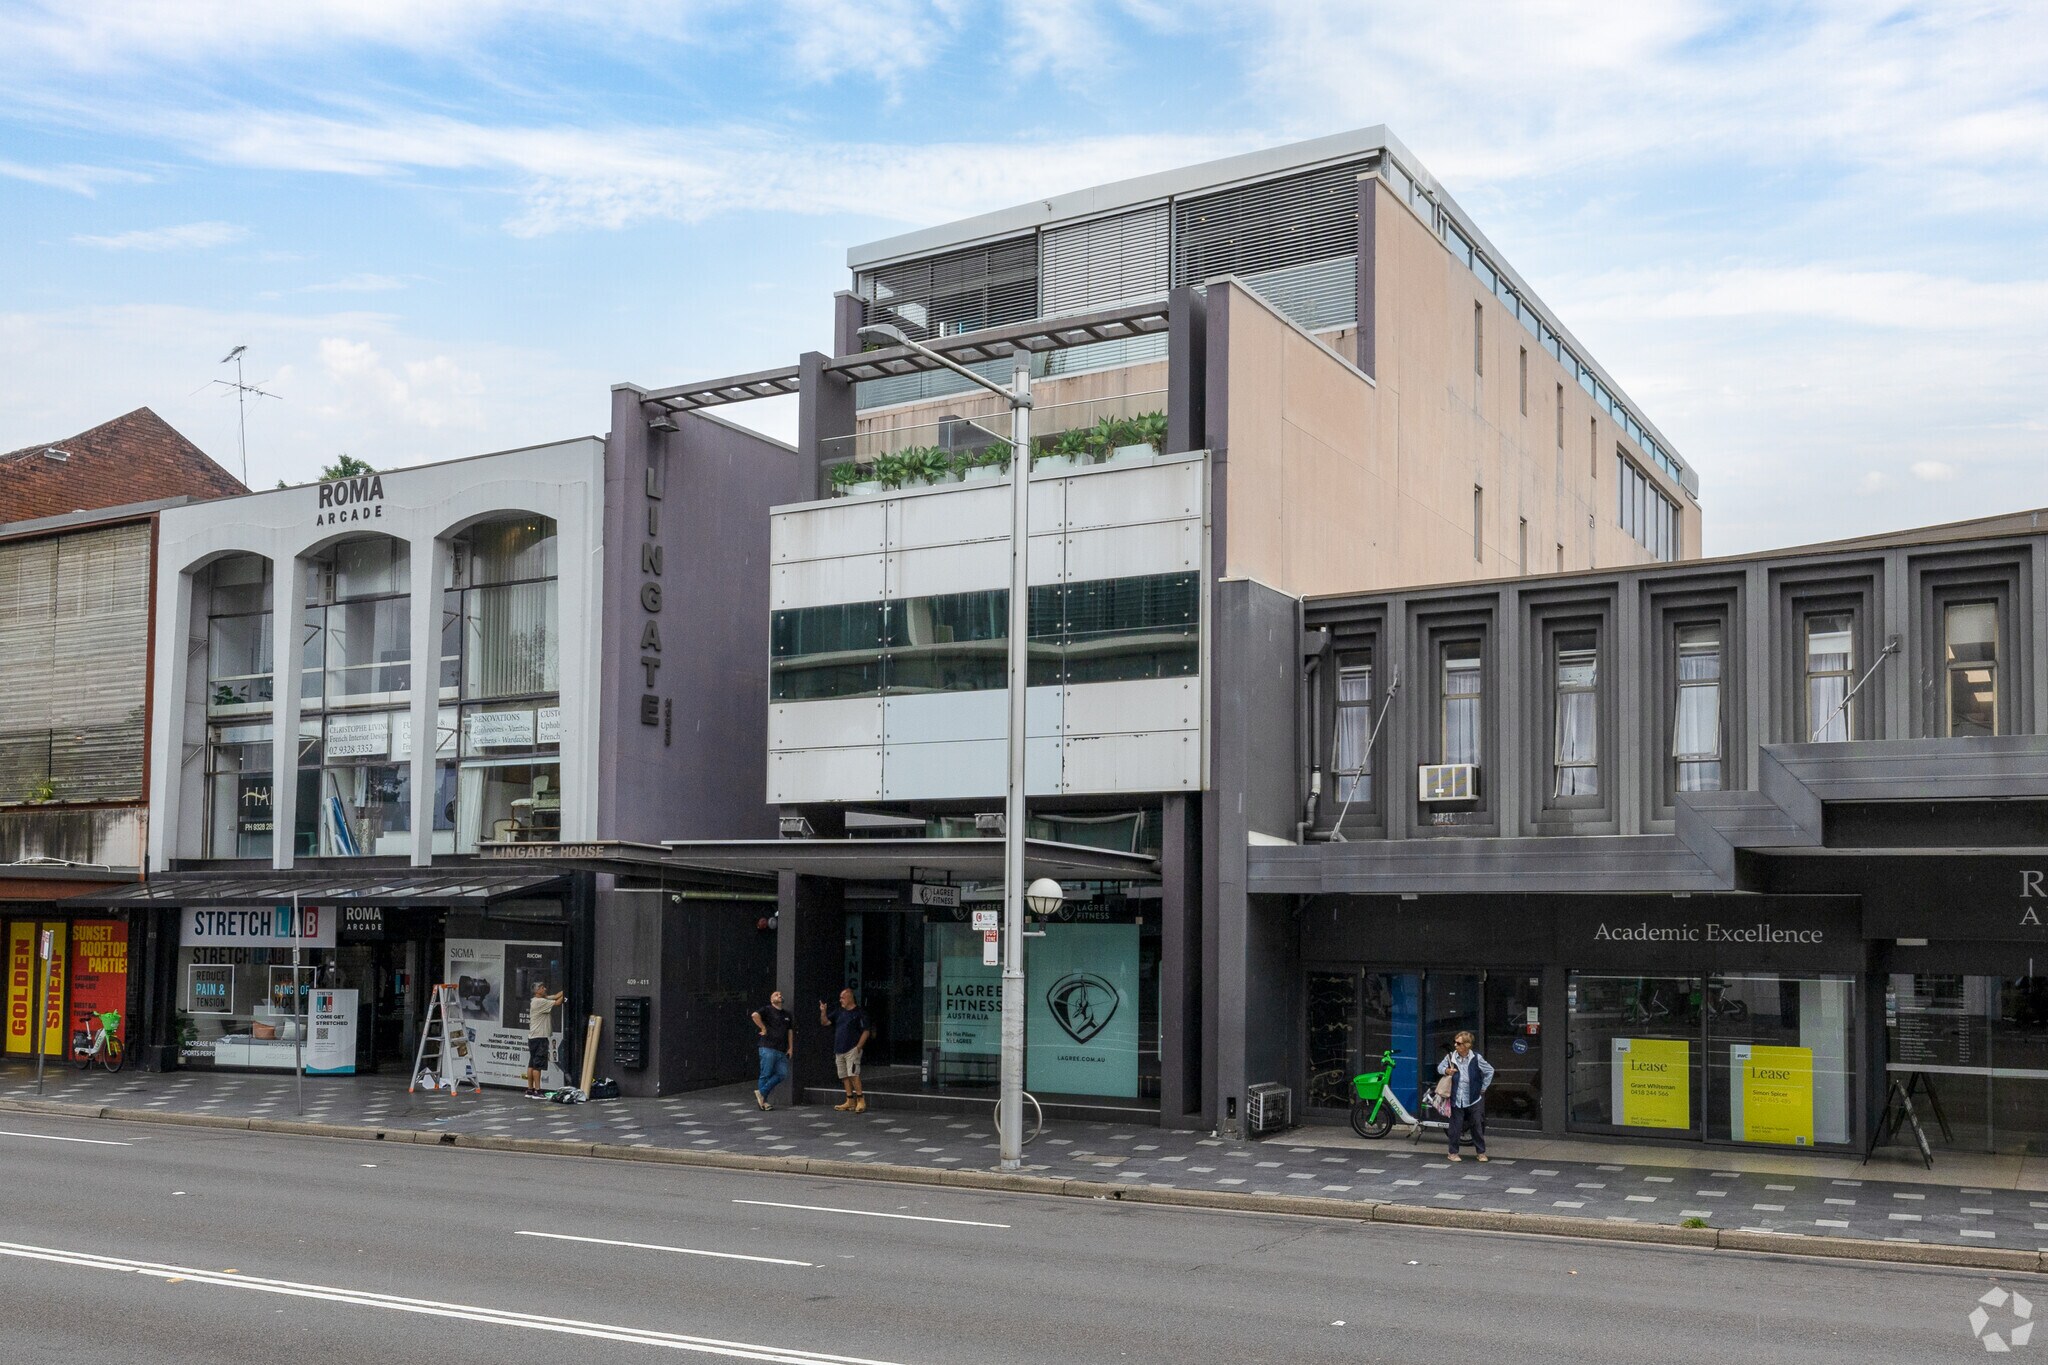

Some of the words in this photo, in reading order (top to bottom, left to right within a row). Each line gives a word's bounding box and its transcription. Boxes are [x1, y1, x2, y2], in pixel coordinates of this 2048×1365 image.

[319, 475, 384, 509] ROMA
[317, 505, 383, 526] ARCADE
[641, 467, 662, 727] LINGATE
[474, 713, 520, 723] RENOVATIONS
[329, 734, 348, 742] French
[349, 733, 370, 742] Interior
[329, 746, 337, 755] 02
[339, 745, 355, 754] 9328
[492, 845, 553, 858] LINGATE
[560, 845, 604, 858] HOUSE
[932, 887, 954, 896] LAGREE
[932, 896, 954, 905] FITNESS
[346, 907, 381, 920] ROMA
[1076, 903, 1110, 912] LAGREE
[1076, 912, 1110, 920] FITNESS
[195, 911, 271, 936] STRETCH
[347, 923, 382, 931] ARCADE
[73, 926, 112, 941] SUNSET
[1593, 922, 1699, 942] Academic
[1706, 922, 1823, 944] Excellence
[80, 942, 128, 957] ROOFTOP
[450, 948, 475, 959] SIGMA
[196, 970, 225, 981] REDUCE
[12, 939, 30, 1037] GOLDEN
[195, 983, 216, 995] PAIN
[219, 984, 225, 995] &
[274, 985, 296, 995] RANG
[946, 984, 1002, 997] LAGREE
[196, 997, 225, 1008] TENSION
[946, 1000, 1002, 1012] FITNESS
[1057, 1055, 1106, 1063] LAGREE.COM.AU
[1631, 1059, 1667, 1073] Lease
[1751, 1066, 1791, 1080] Lease
